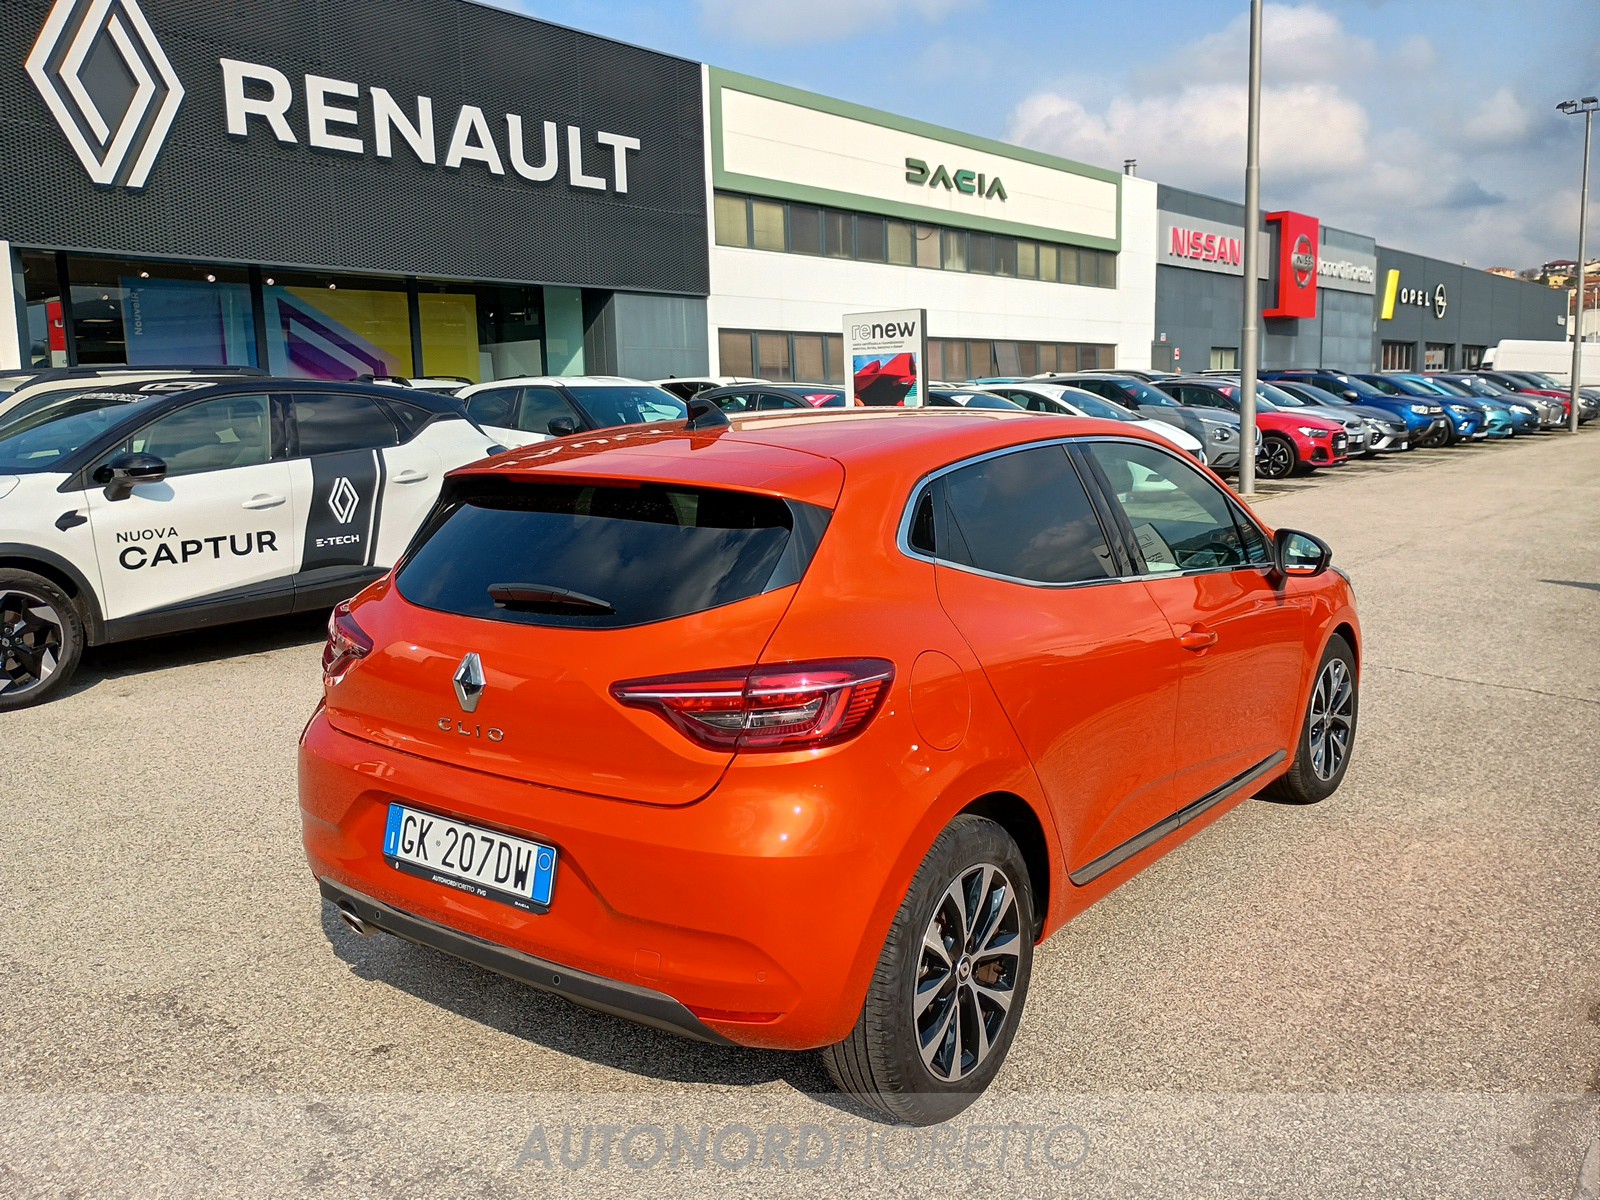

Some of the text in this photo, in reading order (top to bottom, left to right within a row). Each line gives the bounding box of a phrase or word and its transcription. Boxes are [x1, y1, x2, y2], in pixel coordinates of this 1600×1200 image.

[219, 57, 641, 193] RENAULT
[905, 157, 1008, 202] DACIA
[1169, 226, 1241, 266] NISSAN
[1401, 287, 1431, 307] OPEL
[851, 321, 916, 340] renew
[116, 527, 179, 544] NUOVA
[118, 530, 279, 571] CAPTUR
[315, 534, 361, 548] E-TECH
[437, 717, 505, 742] CLIO
[401, 815, 434, 861] GK
[441, 827, 532, 891] 207DW
